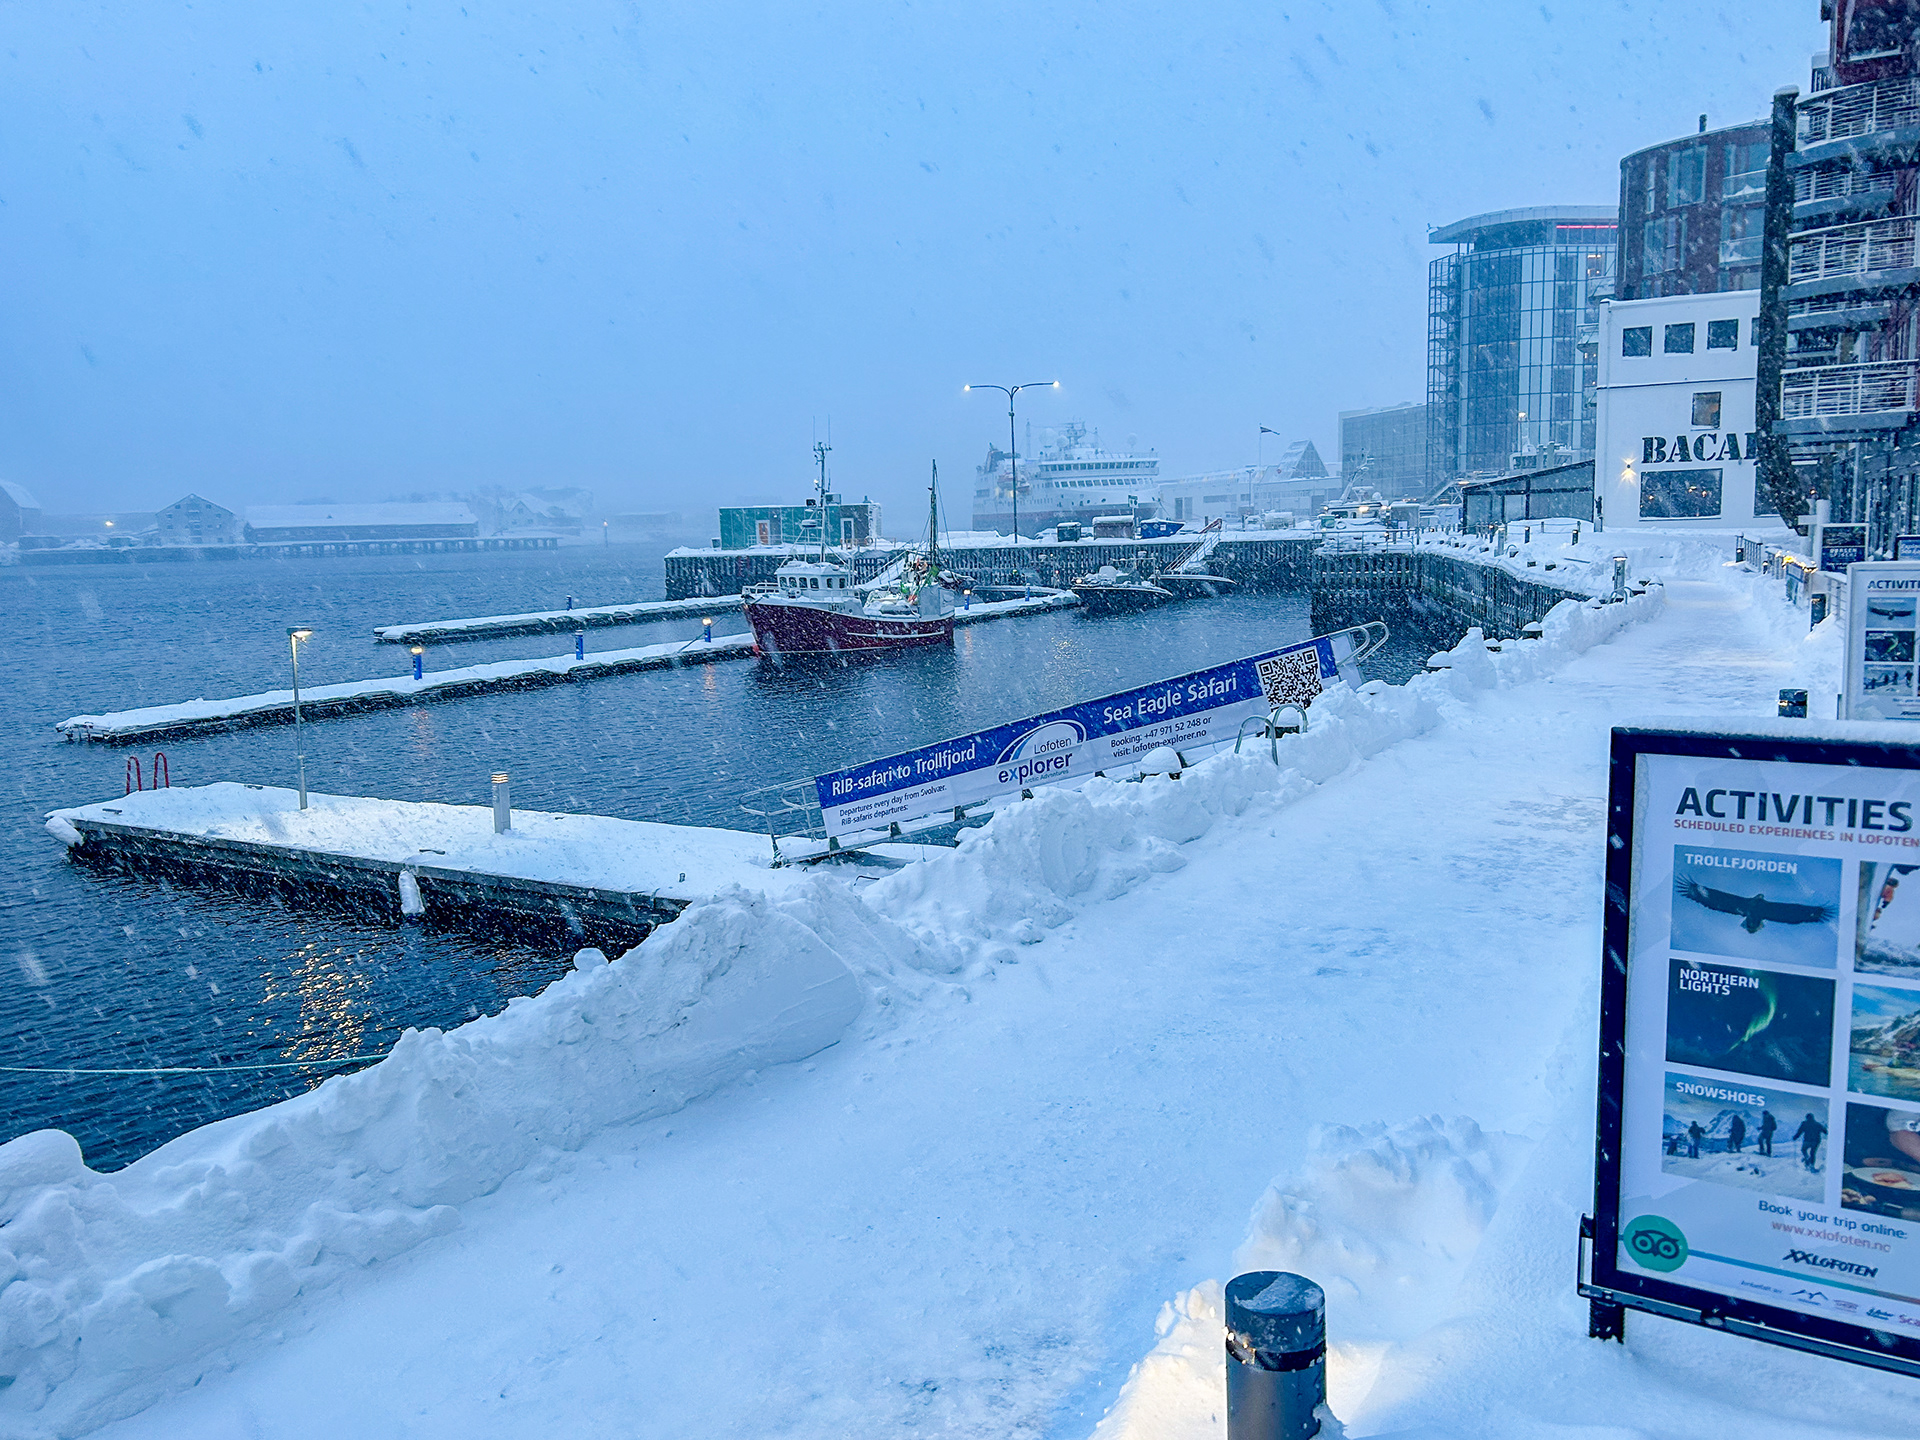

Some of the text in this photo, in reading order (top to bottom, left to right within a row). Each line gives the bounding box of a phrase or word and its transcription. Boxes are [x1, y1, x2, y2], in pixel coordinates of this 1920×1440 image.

[1103, 672, 1237, 724] Sea Eagle Safari
[1034, 737, 1072, 755] Lofoten
[1111, 716, 1211, 748] Booking: +47 971 52 248 or
[1113, 729, 1207, 758] visit: lofoten-explorer.no
[832, 742, 976, 797] RIB-safari to Trollfjord
[998, 753, 1073, 785] explorer
[839, 802, 873, 817] Departures
[873, 798, 890, 809] every
[891, 795, 903, 805] day
[904, 789, 919, 801] from
[873, 804, 909, 818] departures:
[1675, 787, 1913, 833] ACTIVITIES
[1674, 818, 1920, 848] SCHEDULED EXPERIENCES IN LOFOTEN
[1685, 853, 1798, 874] TROLLFJORDEN
[1679, 979, 1731, 996] LIGHTS
[1680, 968, 1760, 989] NORTHERN
[1675, 1081, 1766, 1107] SNOWSHOES
[1758, 1199, 1908, 1240] Book your trip online:
[1783, 1248, 1879, 1278] XXLOFOTEN
